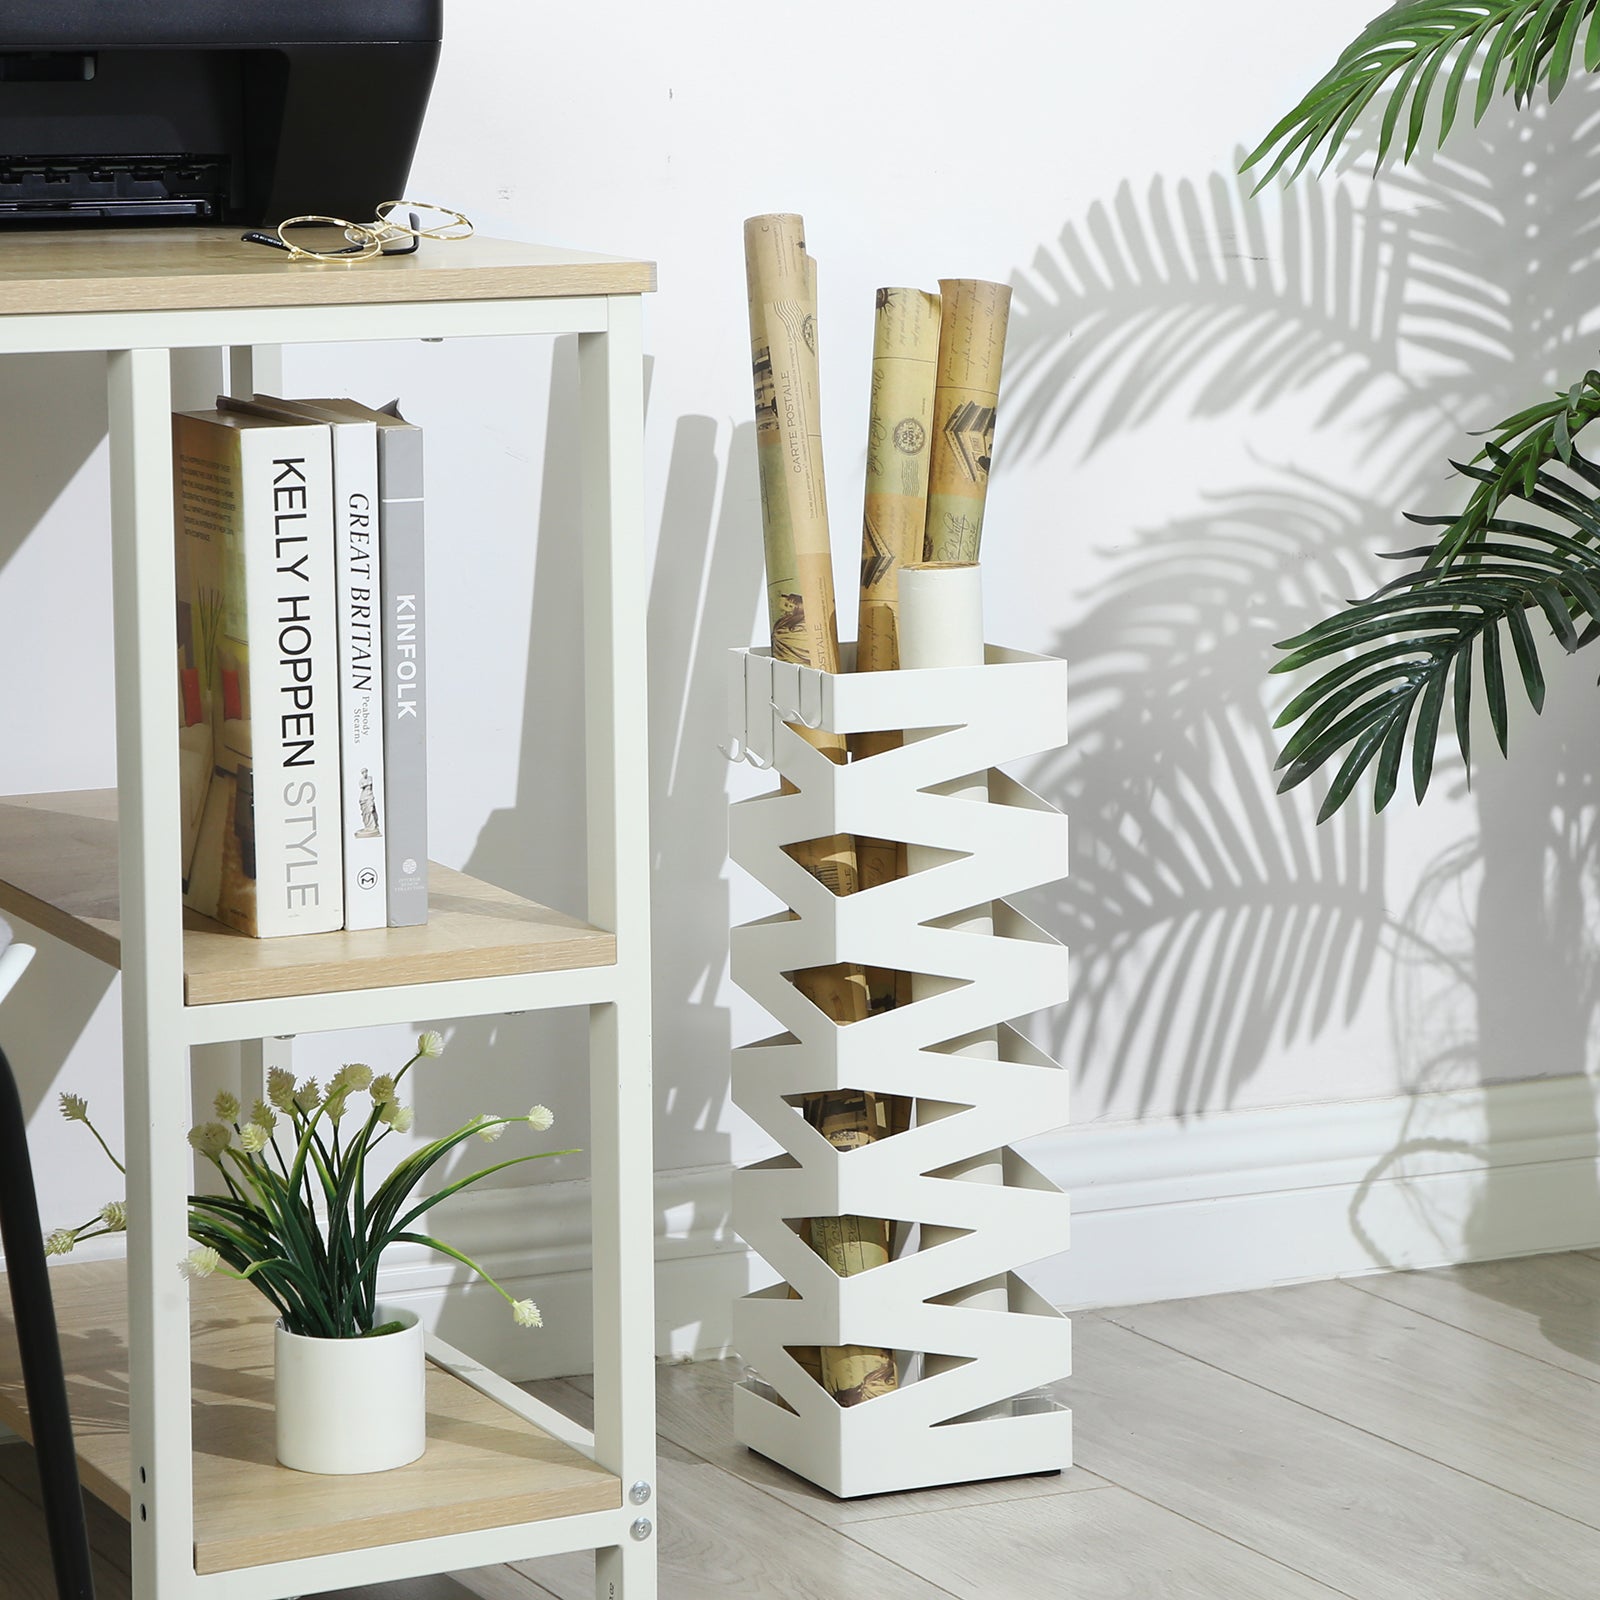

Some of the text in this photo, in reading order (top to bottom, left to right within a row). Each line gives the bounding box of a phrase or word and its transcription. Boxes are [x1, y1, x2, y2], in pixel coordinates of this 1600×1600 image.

[780, 370, 797, 428] POSTALE
[788, 431, 802, 474] CARTE
[348, 492, 374, 692] GREAT BRITAIN
[272, 458, 319, 910] KELLY HOPPEN STYLE
[397, 593, 417, 720] KINFOLK
[353, 708, 363, 744] Stearns
[360, 695, 371, 737] Peabody
